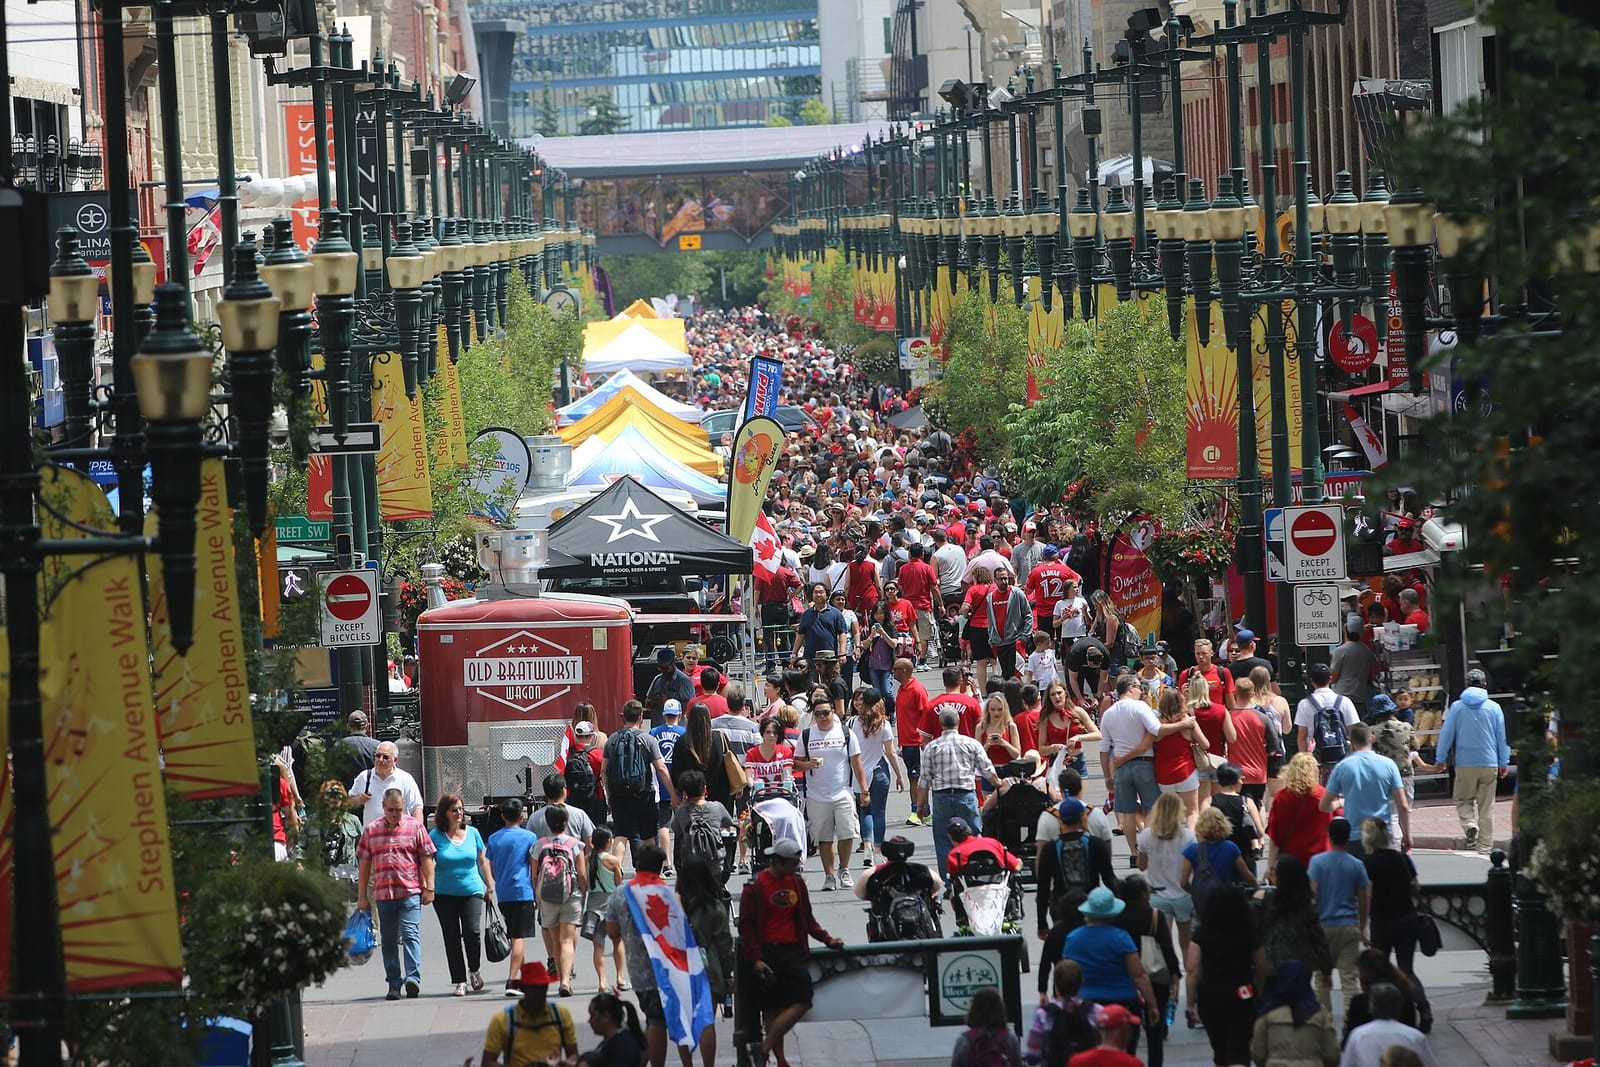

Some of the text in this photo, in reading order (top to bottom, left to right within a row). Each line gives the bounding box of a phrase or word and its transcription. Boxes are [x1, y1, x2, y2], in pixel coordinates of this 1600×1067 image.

[80, 249, 111, 257] ampus
[753, 371, 769, 416] PAIN
[449, 394, 462, 437] Stephen
[1290, 384, 1302, 437] Stephen
[409, 396, 426, 480] Stephen Ave
[436, 405, 449, 457] Stepen
[765, 442, 779, 465] Queen
[506, 463, 521, 473] 105
[1321, 481, 1364, 497] ALGARY
[275, 526, 324, 538] TREET SW
[590, 551, 680, 567] NATIONAL
[1300, 558, 1331, 568] EXCEPT
[1295, 568, 1337, 578] BICYCLES
[1040, 578, 1064, 598] 12
[1122, 582, 1149, 601] what's
[202, 473, 244, 726] Stephen Avenue Walk
[1119, 595, 1158, 616] appening
[1311, 610, 1324, 618] USE
[334, 622, 365, 632] EXCEPT
[1299, 621, 1338, 630] PEDESTRIAN
[330, 632, 371, 643] BICYCLES
[1306, 632, 1330, 640] SIGNAL
[468, 660, 578, 682] OLD BRATWURST
[505, 686, 541, 700] WAGON
[103, 575, 165, 894] Stephen Avenue Walk
